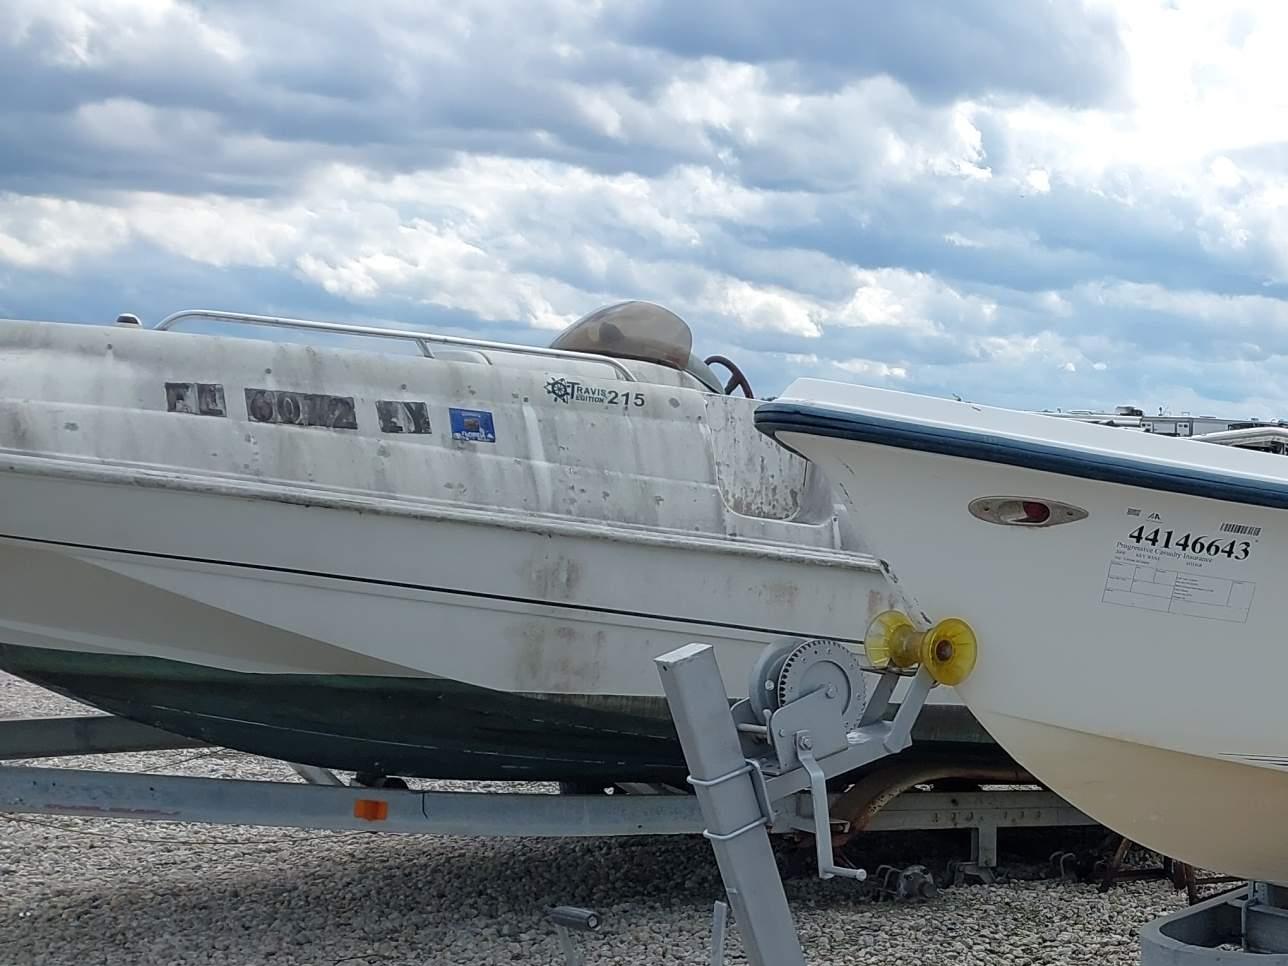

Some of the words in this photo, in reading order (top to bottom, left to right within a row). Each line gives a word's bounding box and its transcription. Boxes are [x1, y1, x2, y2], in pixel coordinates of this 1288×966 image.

[575, 395, 605, 403] EDITION
[607, 390, 646, 407] 215
[1116, 541, 1154, 554] Progressive
[1154, 548, 1181, 559] Casualty
[1183, 552, 1214, 563] Insurance
[1128, 525, 1251, 561] 44146643
